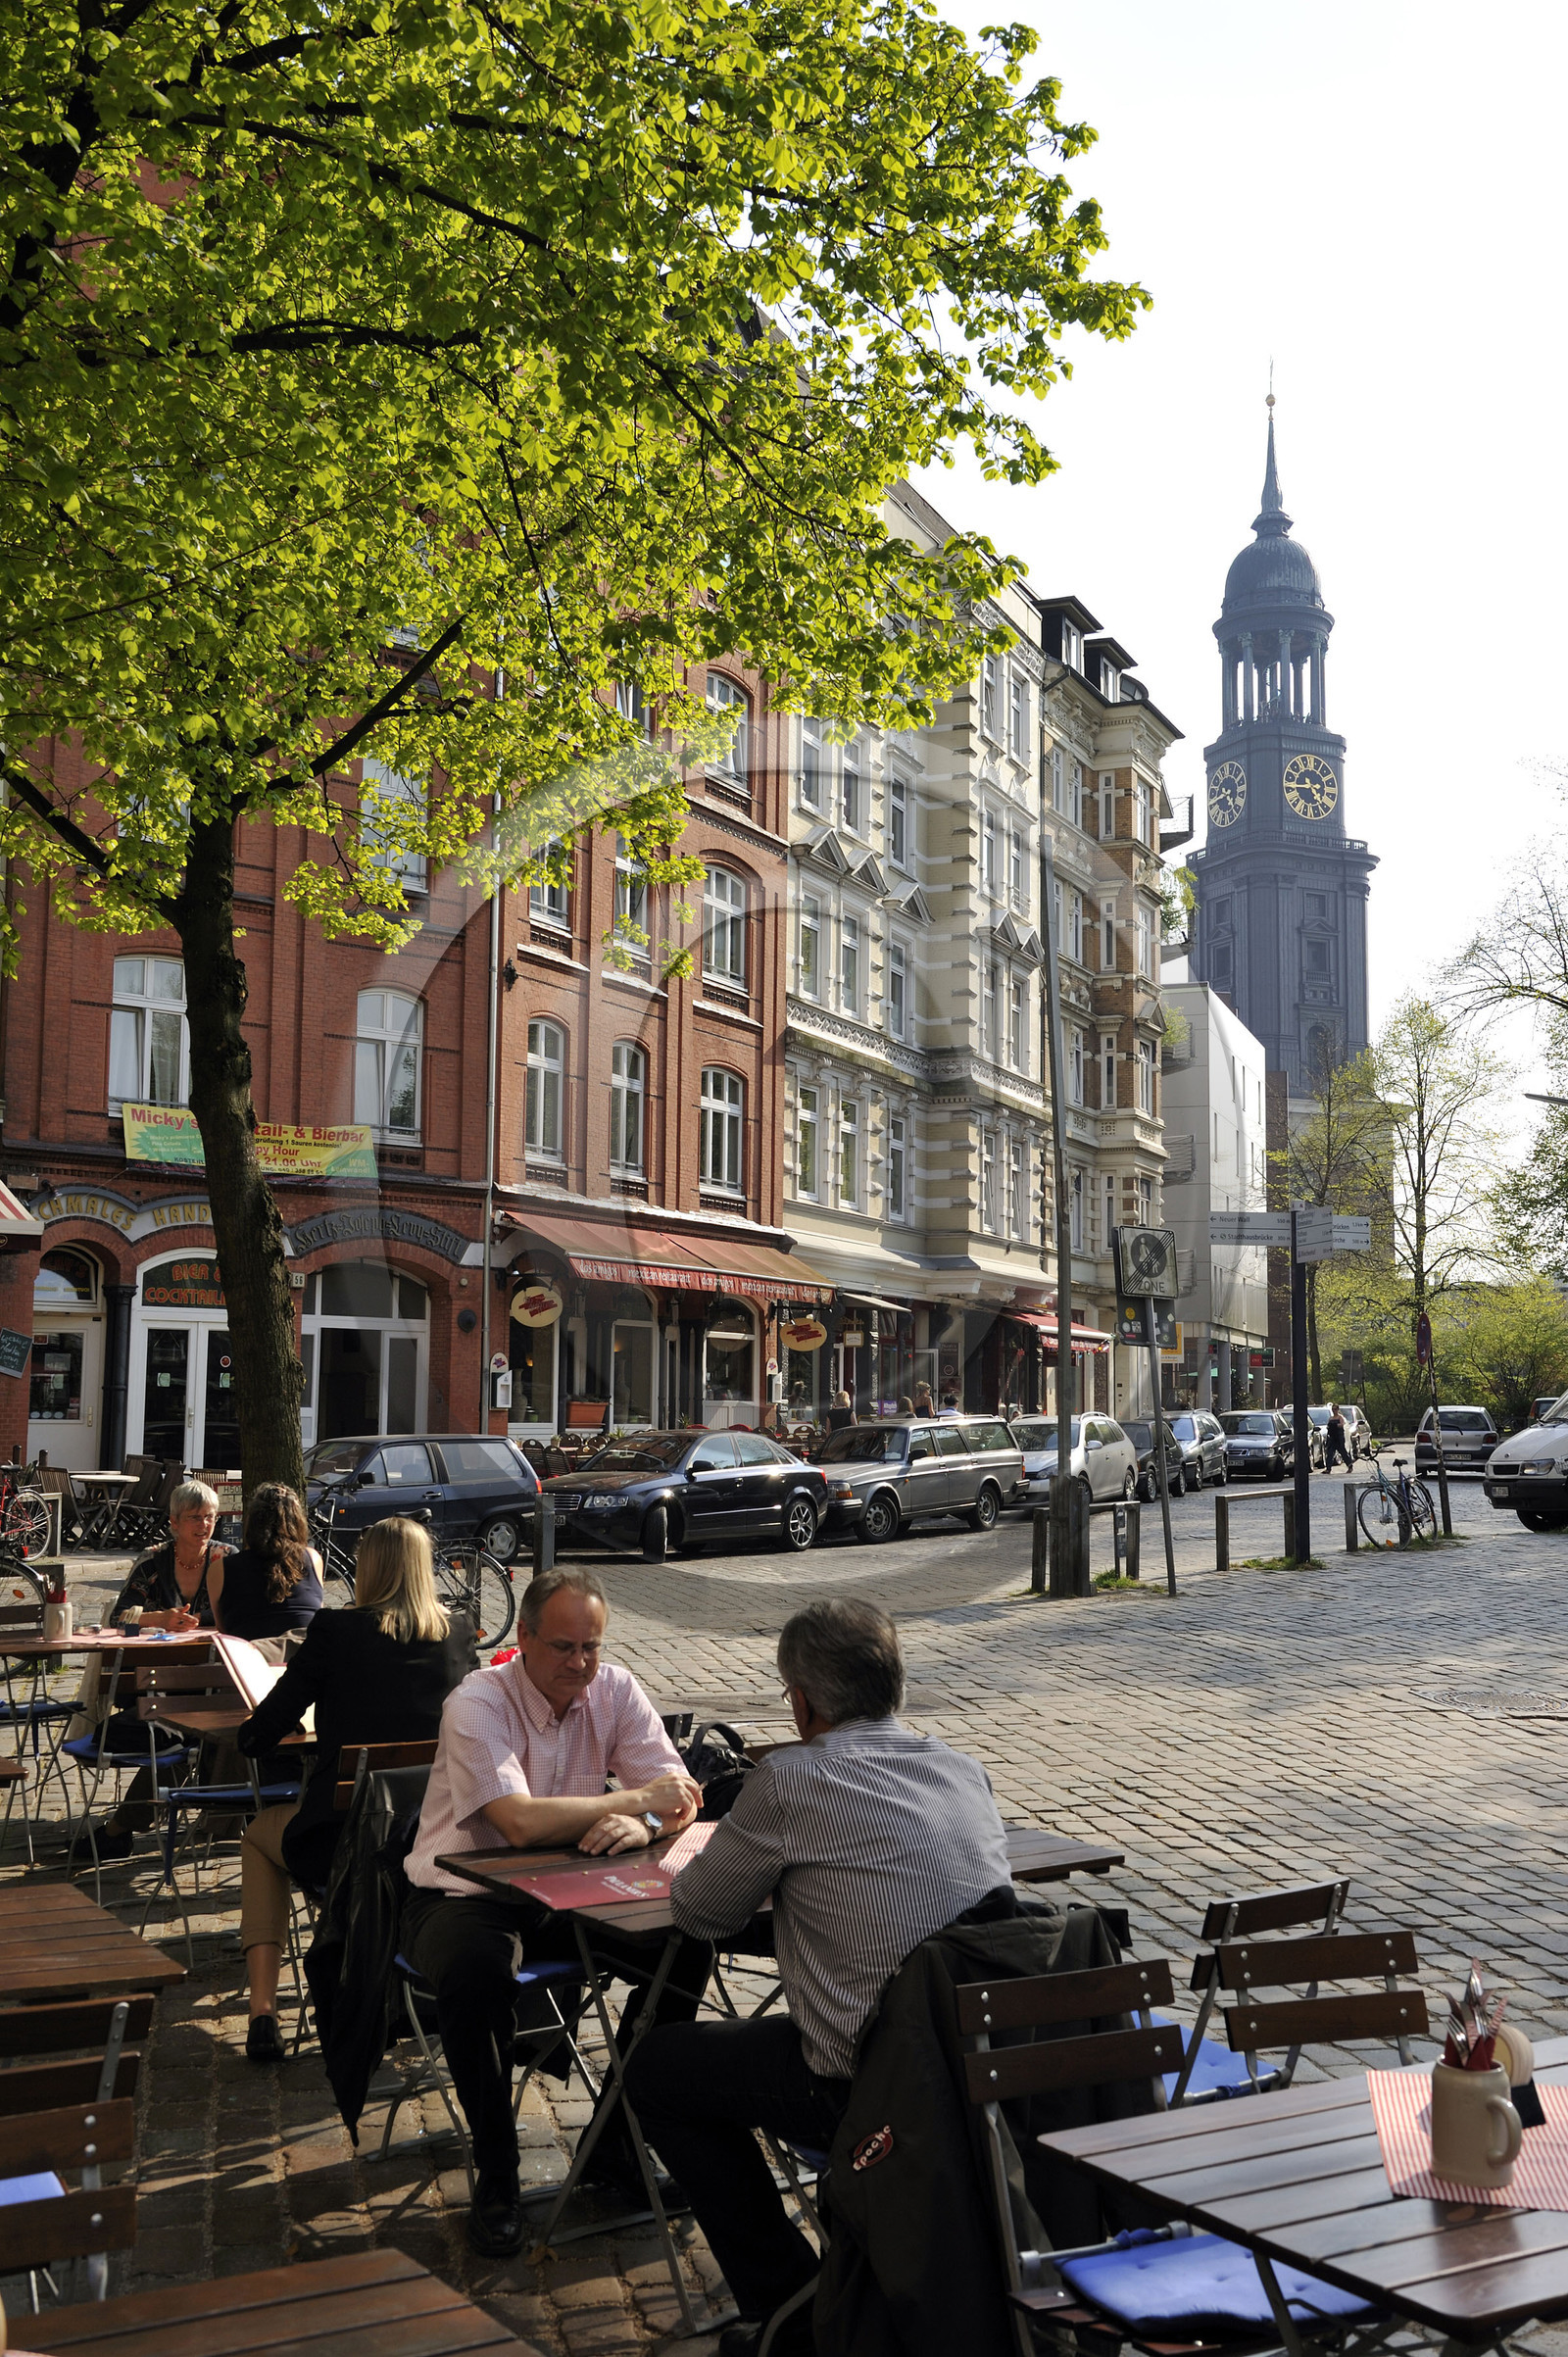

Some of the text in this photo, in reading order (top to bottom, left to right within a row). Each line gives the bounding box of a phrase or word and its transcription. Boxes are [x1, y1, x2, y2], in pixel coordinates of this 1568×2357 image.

[254, 1125, 364, 1142] tail- & Bierbar
[255, 1145, 300, 1155] py Hour
[265, 1156, 322, 1168] 21.00 Uhr
[153, 1203, 211, 1226] HAND
[579, 1259, 593, 1274] dos
[593, 1262, 617, 1279] amigos
[628, 1266, 658, 1280] mexican
[659, 1270, 691, 1284] restaurant
[702, 1273, 713, 1286] dos
[294, 1276, 304, 1285] 56
[1138, 1281, 1165, 1293] ZONE
[144, 1287, 226, 1305] COCKTAIL
